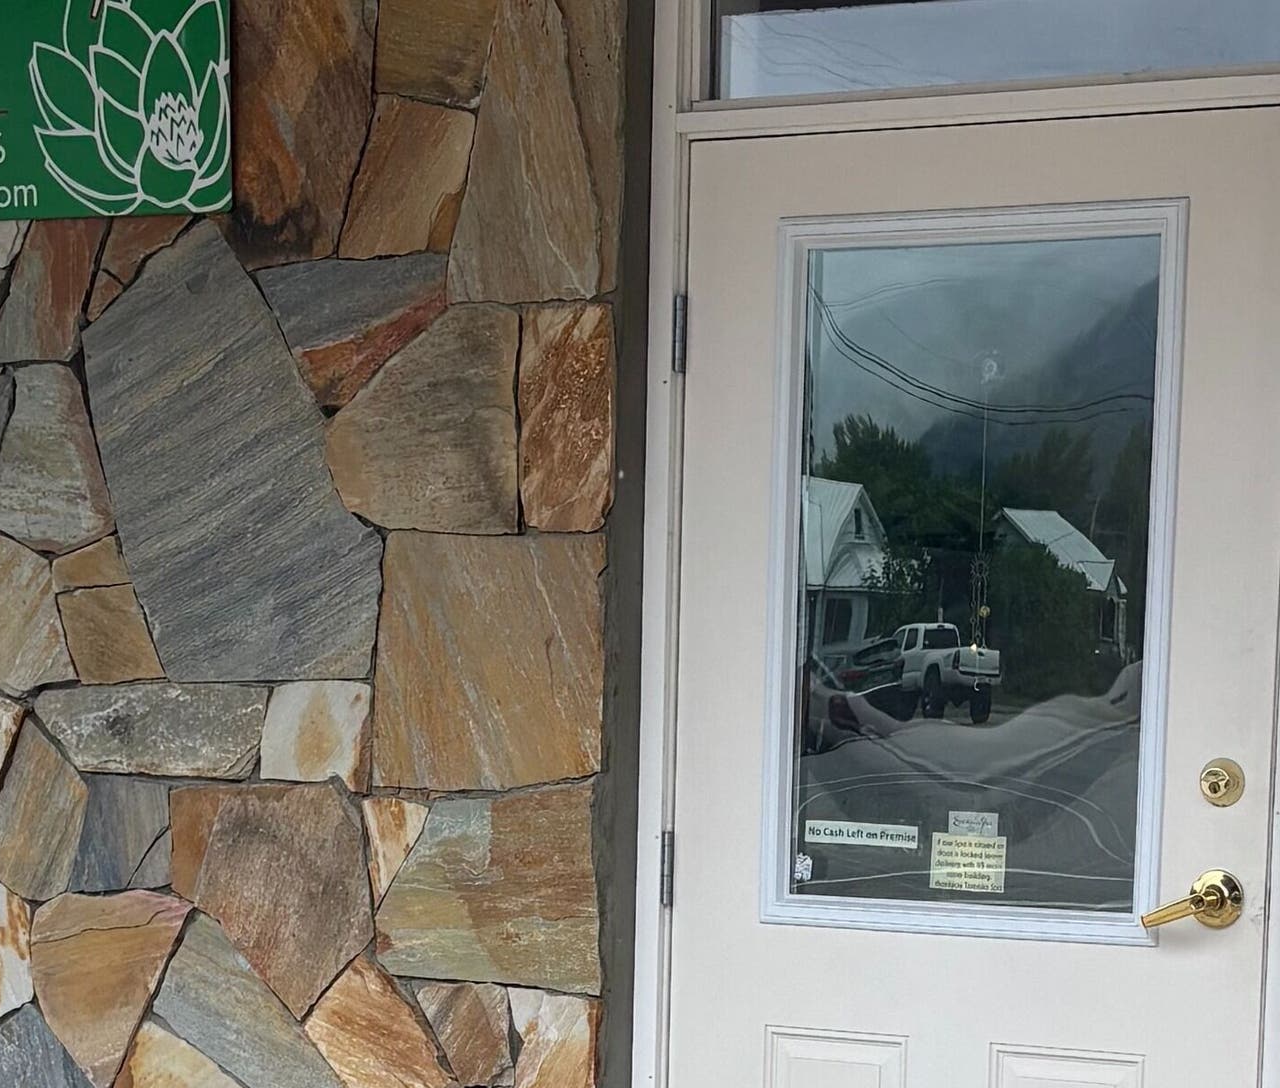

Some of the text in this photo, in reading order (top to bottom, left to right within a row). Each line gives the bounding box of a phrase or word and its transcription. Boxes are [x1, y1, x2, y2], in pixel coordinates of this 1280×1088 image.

[808, 826, 821, 836] No
[823, 827, 844, 837] Cash
[847, 829, 863, 838] Left
[866, 832, 878, 840] on
